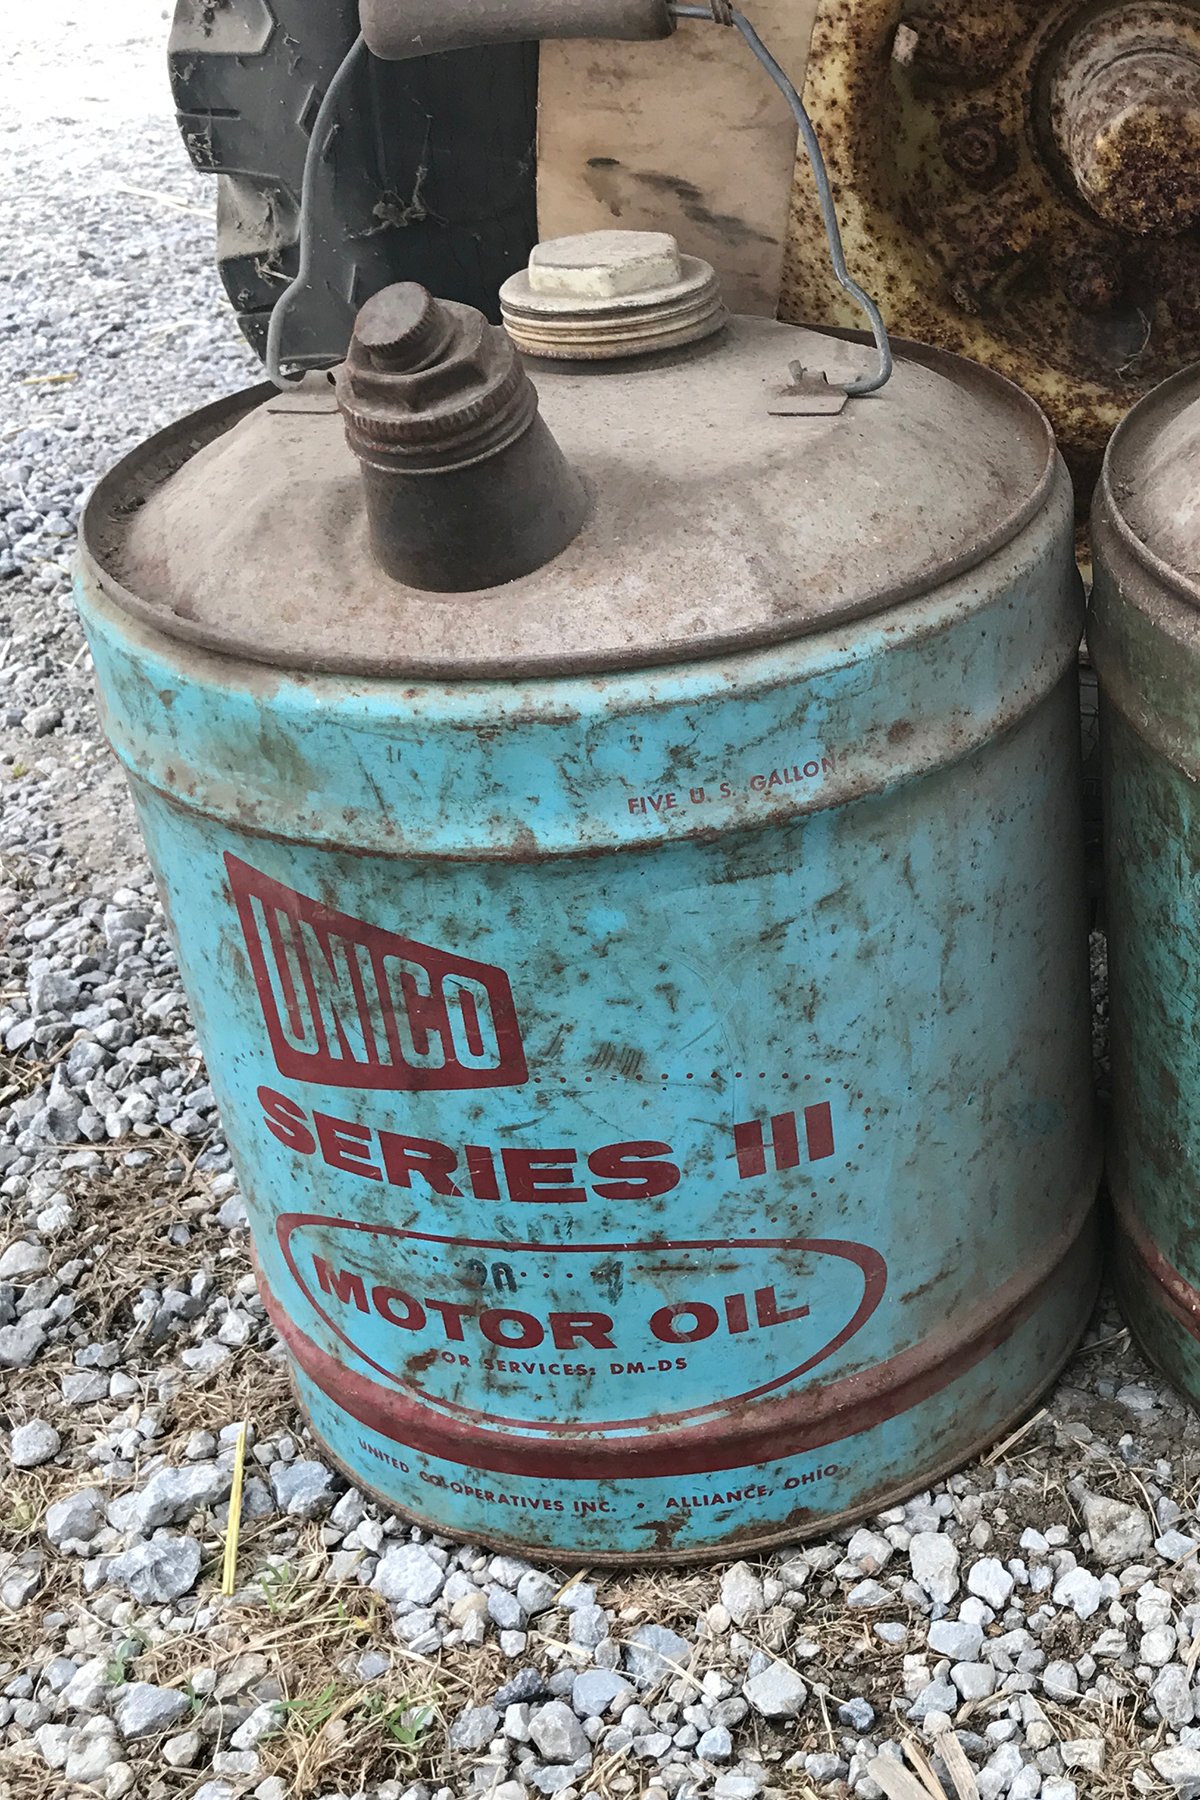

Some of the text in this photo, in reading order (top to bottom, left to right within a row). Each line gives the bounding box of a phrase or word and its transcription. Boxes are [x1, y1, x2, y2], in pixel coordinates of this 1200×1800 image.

[628, 792, 677, 815] FIVE
[247, 892, 502, 1071] UNICO
[256, 1085, 836, 1204] SERIES III
[311, 1253, 616, 1351] MOTOR
[650, 1285, 811, 1344] OIL
[438, 1349, 688, 1376] OR SERVICES: DM-DS
[357, 1436, 410, 1474] UNITED
[573, 1500, 617, 1514] INC.
[665, 1483, 774, 1509] ALLIANCE,
[784, 1463, 839, 1491] OHIO
